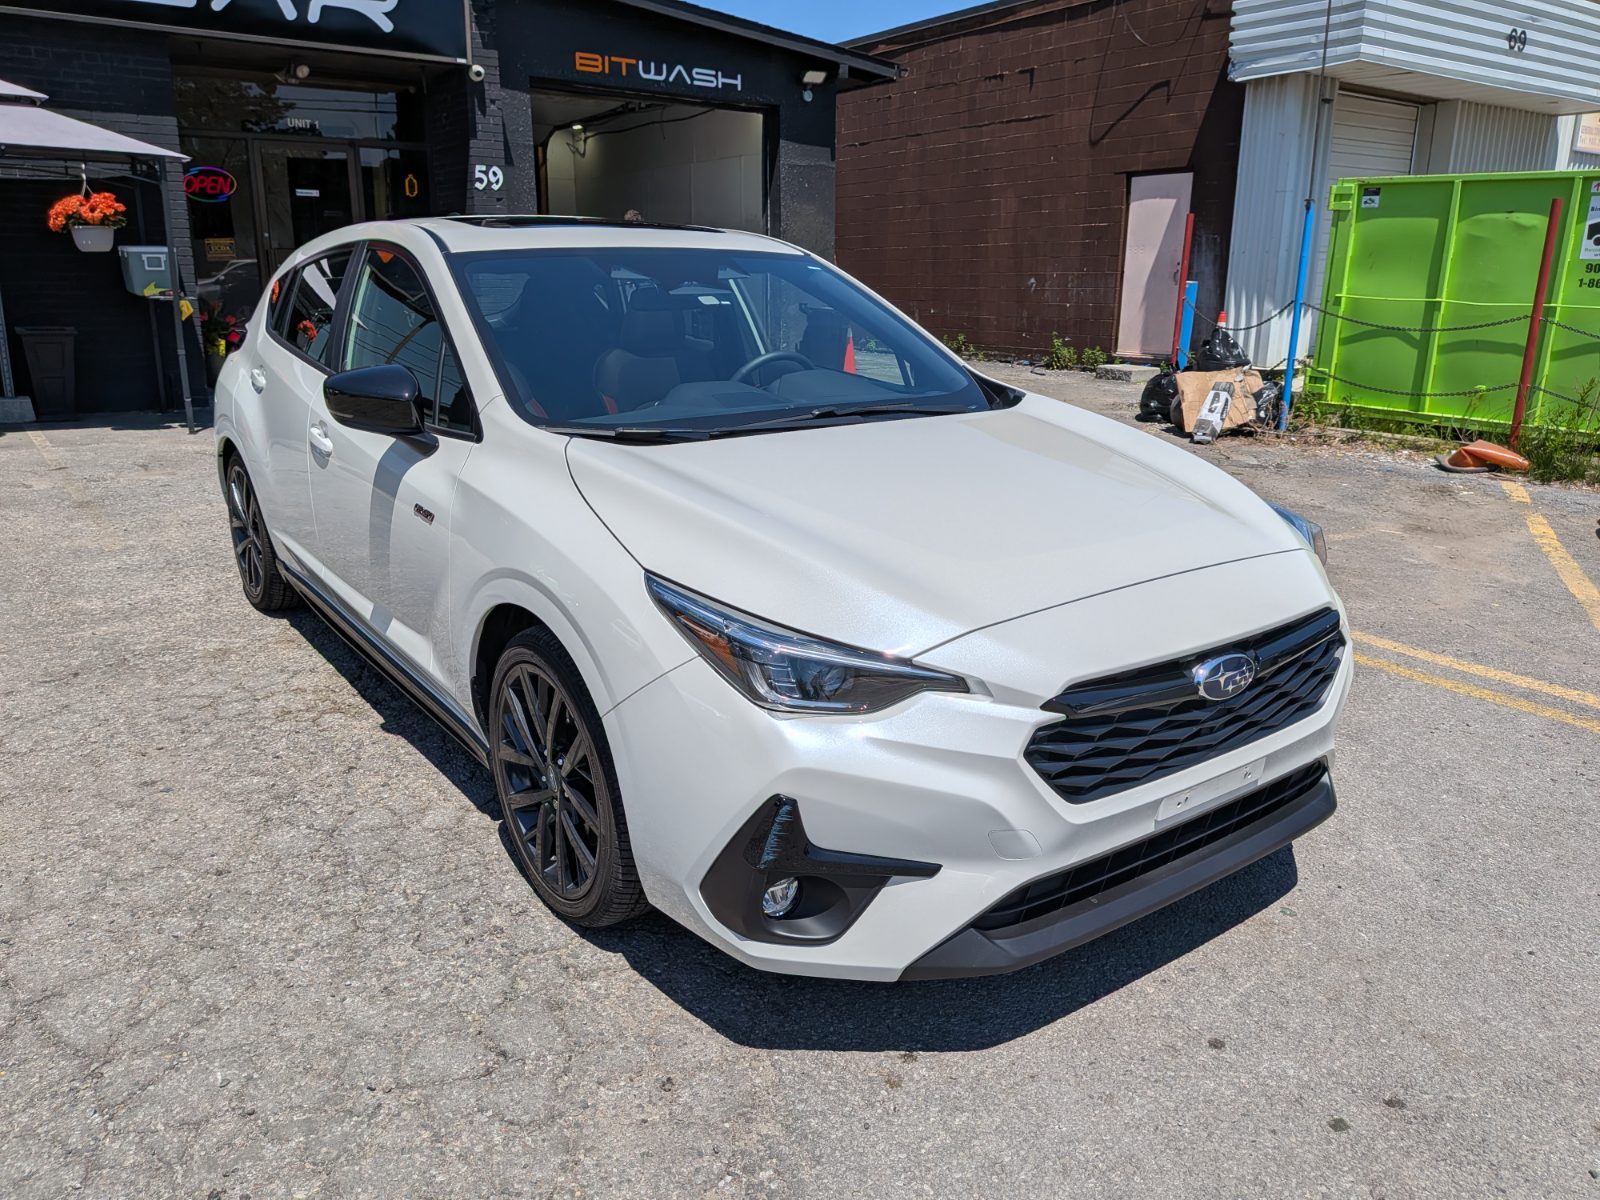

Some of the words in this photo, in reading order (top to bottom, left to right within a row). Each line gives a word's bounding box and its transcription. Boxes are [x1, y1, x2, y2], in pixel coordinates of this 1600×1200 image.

[1509, 28, 1526, 52] 69
[287, 117, 311, 129] UNIT
[314, 120, 319, 129] 1
[183, 175, 231, 194] OPEN
[474, 164, 504, 191] 59
